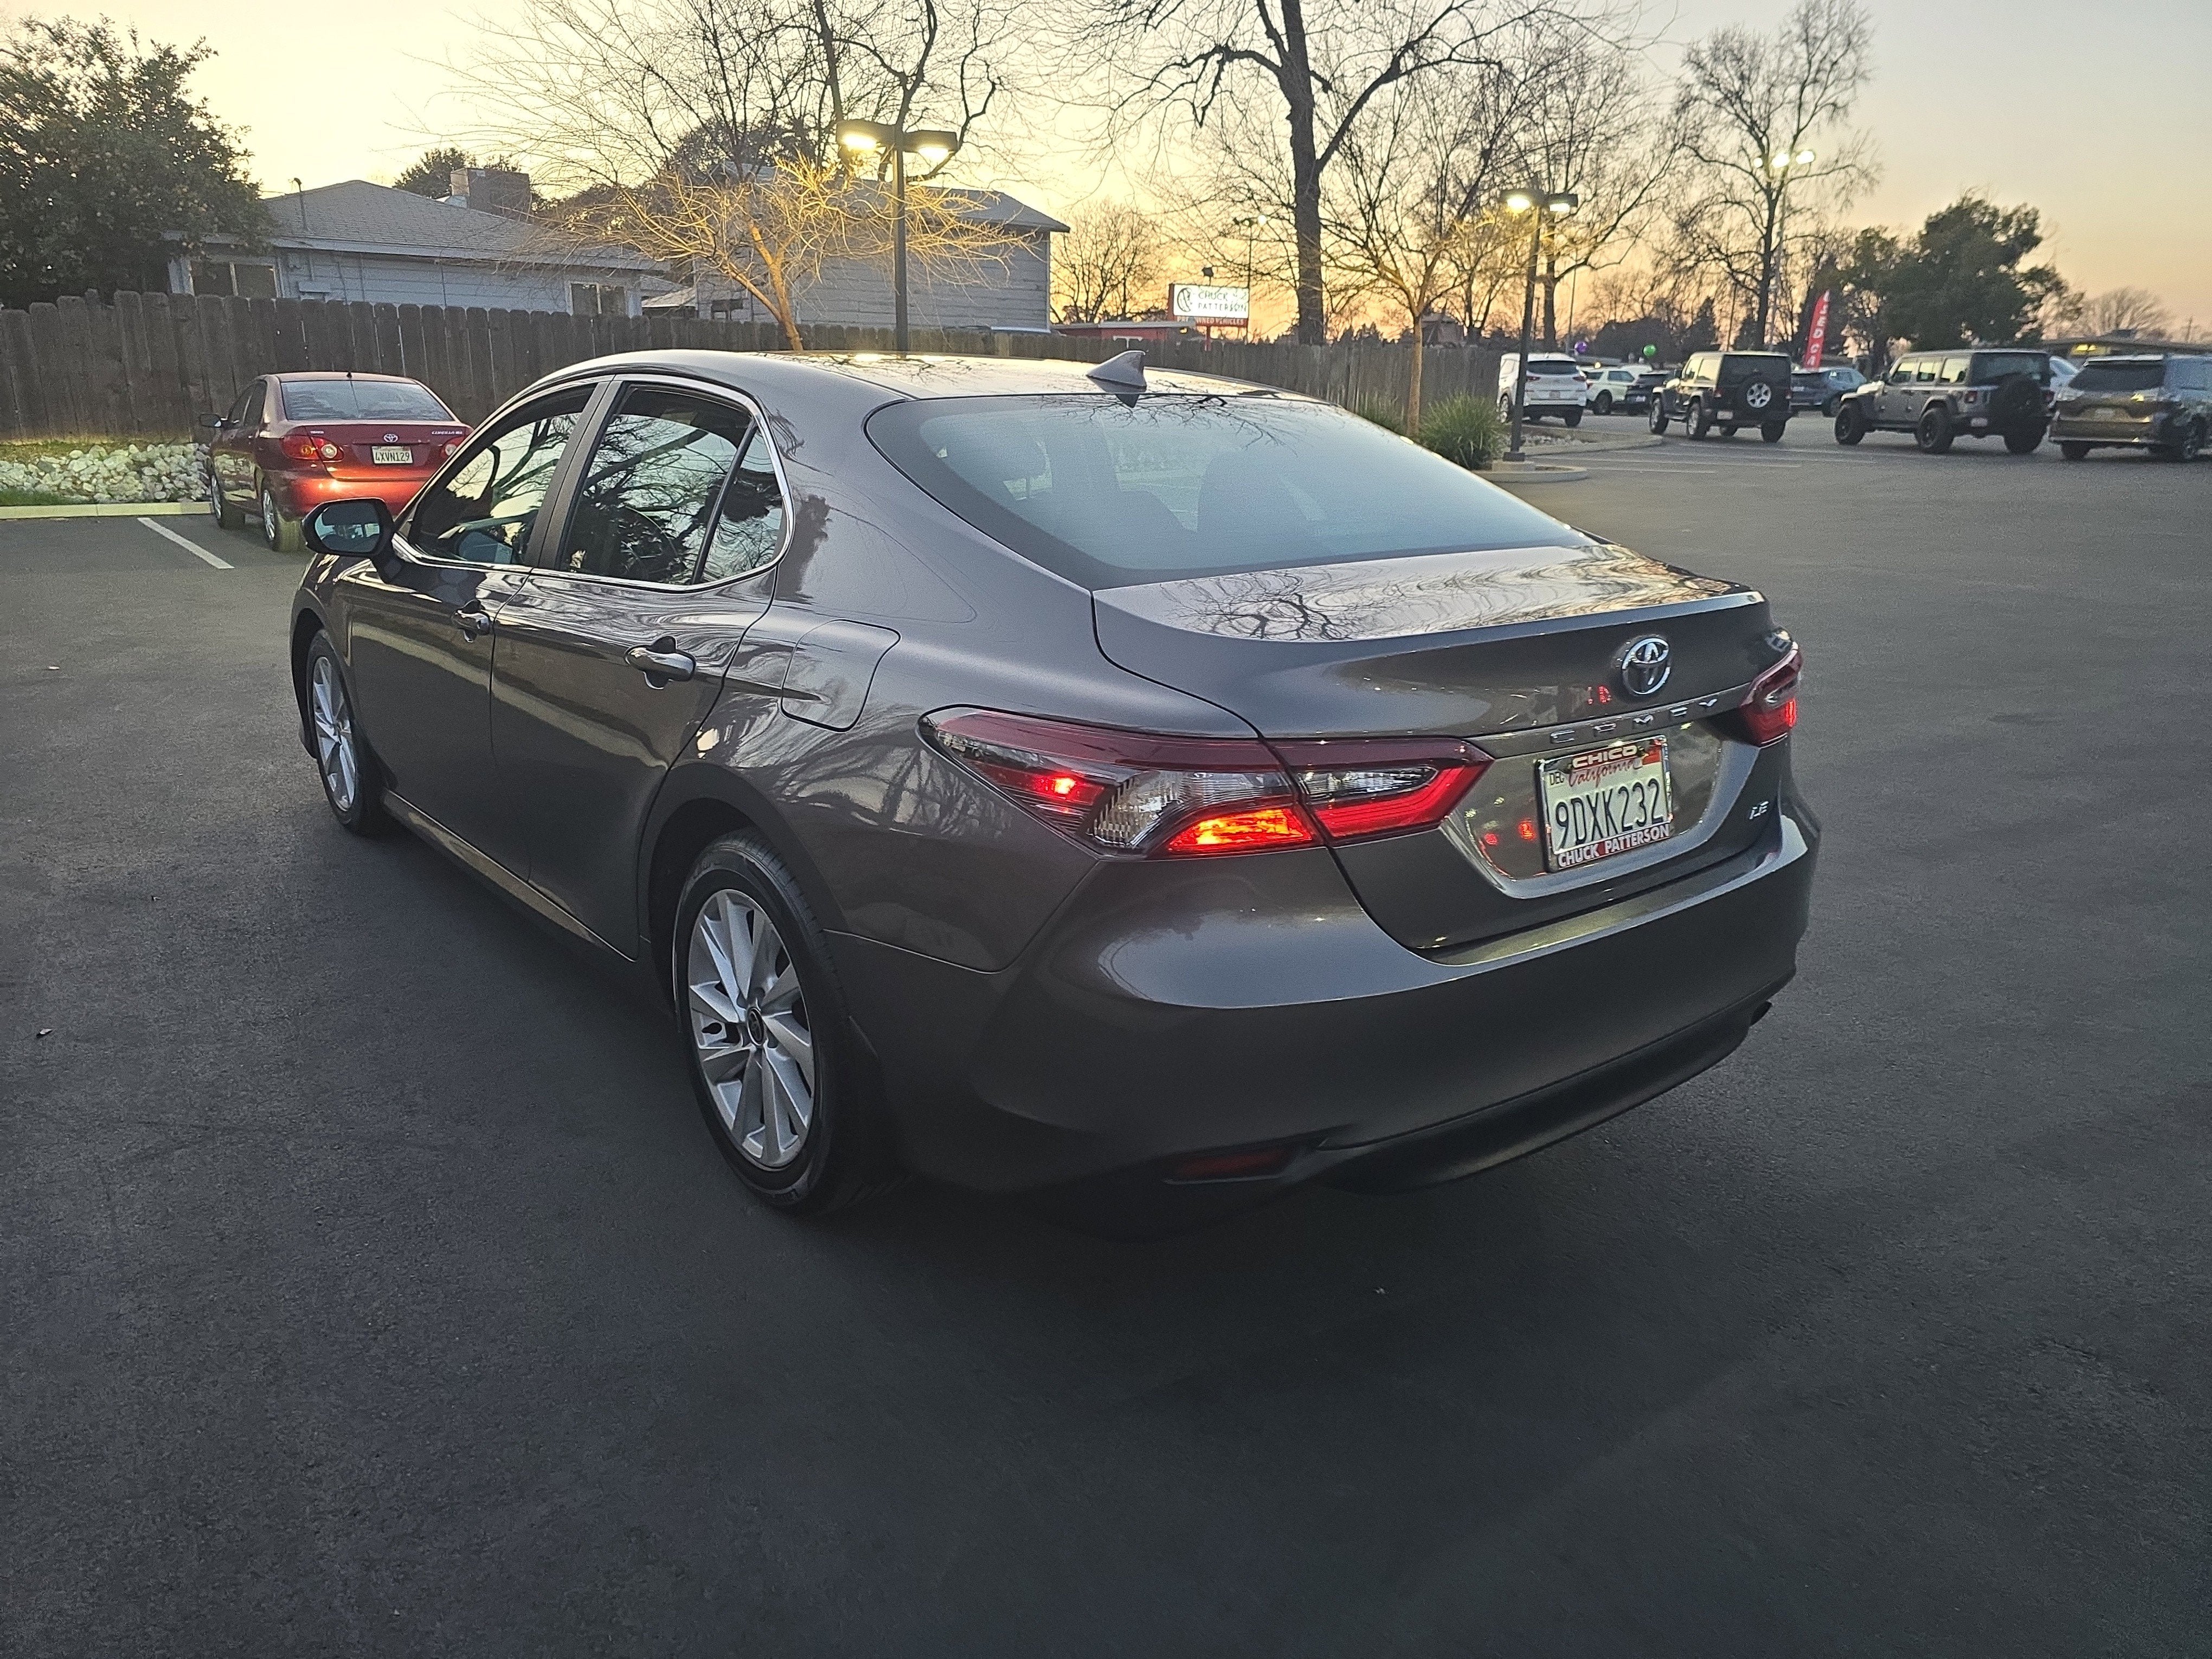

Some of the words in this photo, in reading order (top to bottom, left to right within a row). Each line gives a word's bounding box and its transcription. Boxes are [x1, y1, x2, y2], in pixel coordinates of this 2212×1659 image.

[1198, 290, 1229, 301] CHUCK
[1198, 302, 1246, 312] PATTERSON
[375, 452, 410, 462] 4XVN129
[1572, 745, 1637, 768] CHICO
[1555, 778, 1664, 851] 9DXK232
[1749, 801, 1769, 820] LE
[1558, 844, 1600, 867] CHUCK
[1604, 824, 1670, 855] PATTERSON
